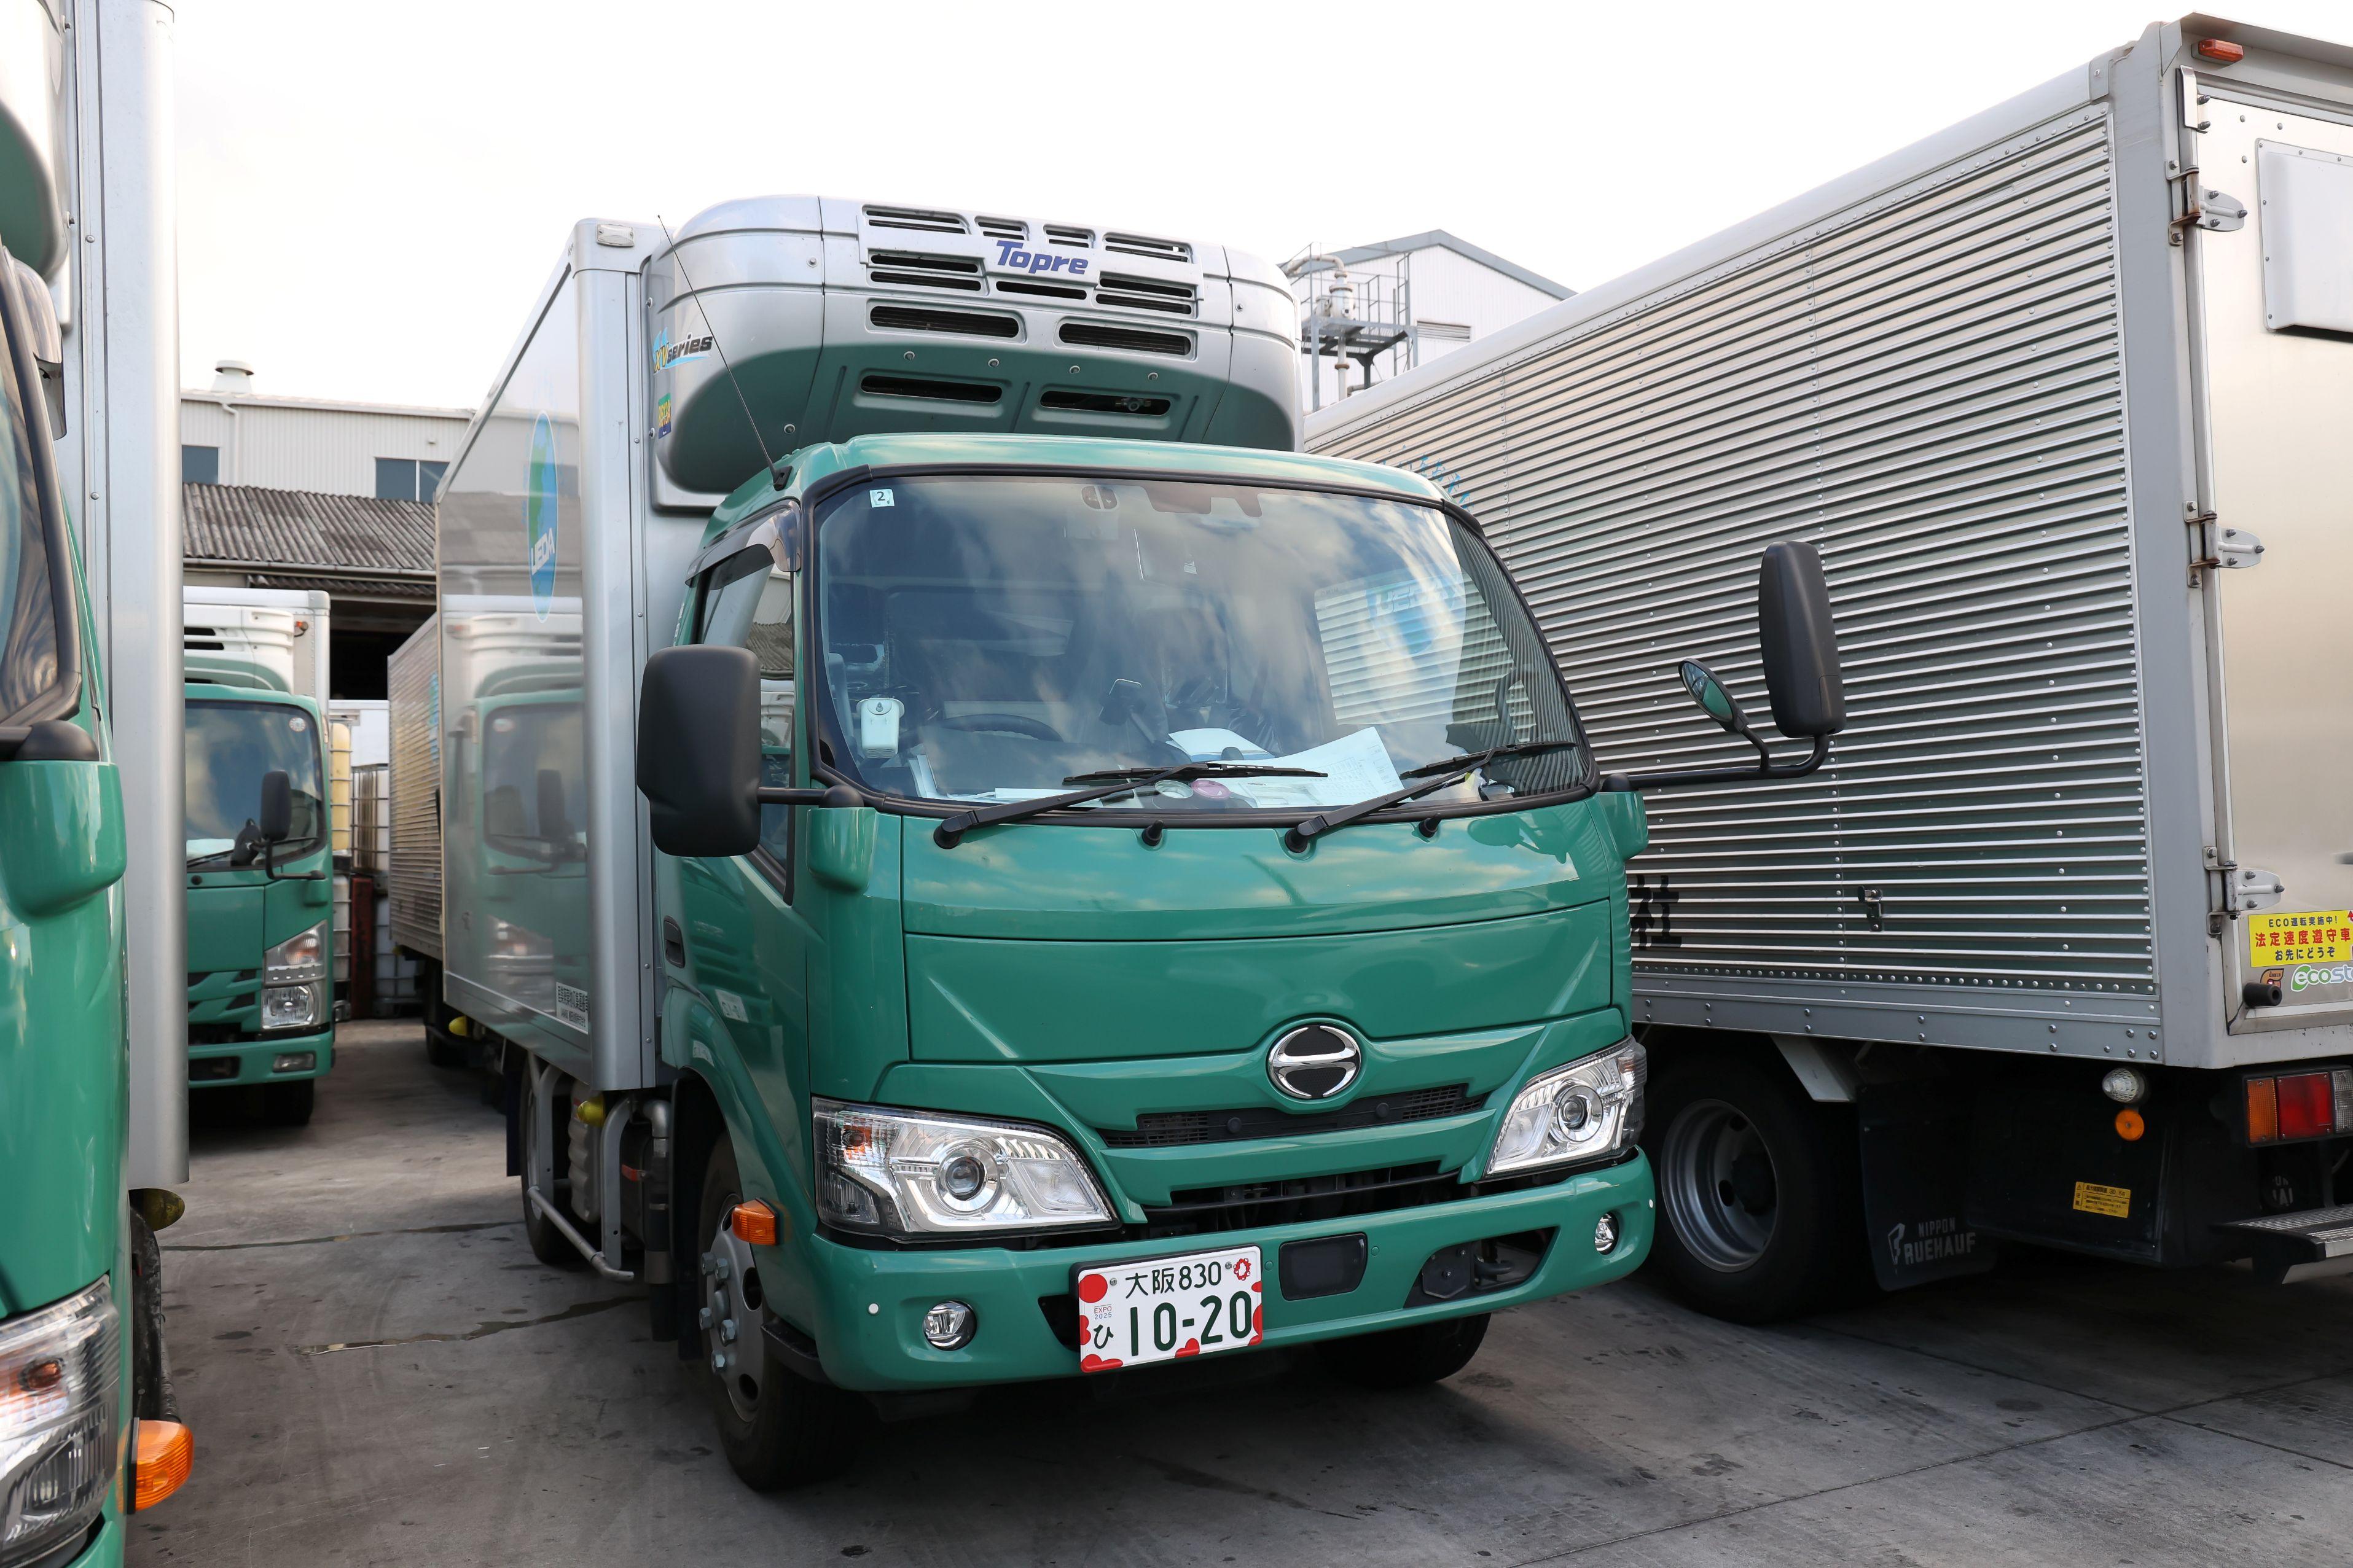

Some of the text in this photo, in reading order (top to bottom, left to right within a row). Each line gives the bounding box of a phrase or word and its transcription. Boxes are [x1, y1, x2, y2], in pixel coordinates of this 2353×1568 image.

[995, 240, 1088, 275] Topre
[877, 491, 885, 501] 2
[2255, 927, 2351, 948] 法定速度遵守車
[2275, 946, 2336, 961] お先にどうぞ
[1918, 1217, 1956, 1238] NIPPON
[1130, 1290, 1252, 1357] 10-20
[1093, 1324, 1114, 1349] ひ
